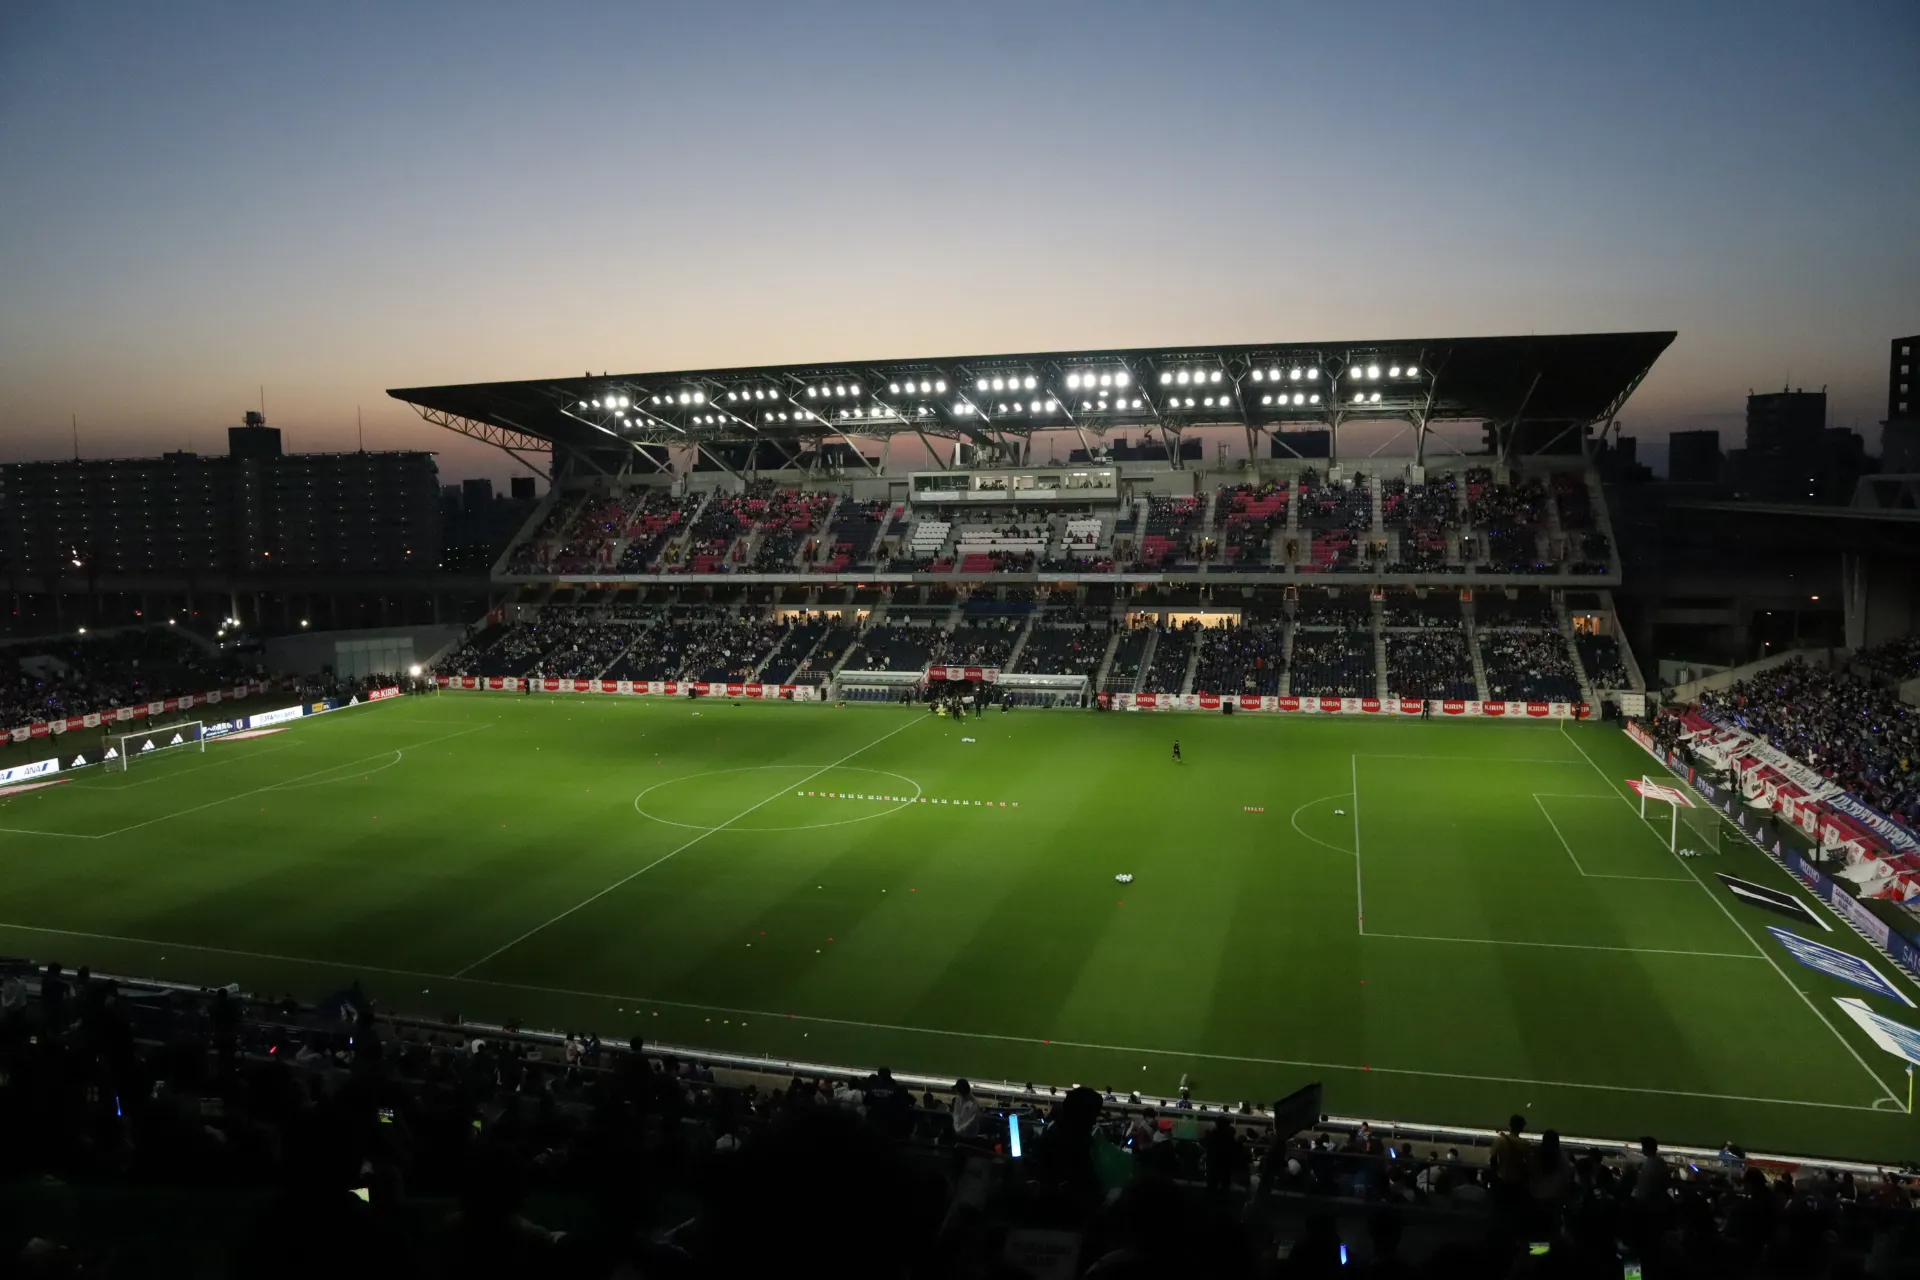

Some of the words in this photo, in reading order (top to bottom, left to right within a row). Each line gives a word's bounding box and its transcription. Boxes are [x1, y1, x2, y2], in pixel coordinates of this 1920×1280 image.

[380, 687, 399, 698] KIRIN
[31, 726, 49, 735] KIRIN
[24, 765, 41, 775] ANA
[1800, 858, 1820, 883] MIZUHO
[1835, 888, 1854, 908] SAMURAI
[1838, 900, 1849, 912] BLUE
